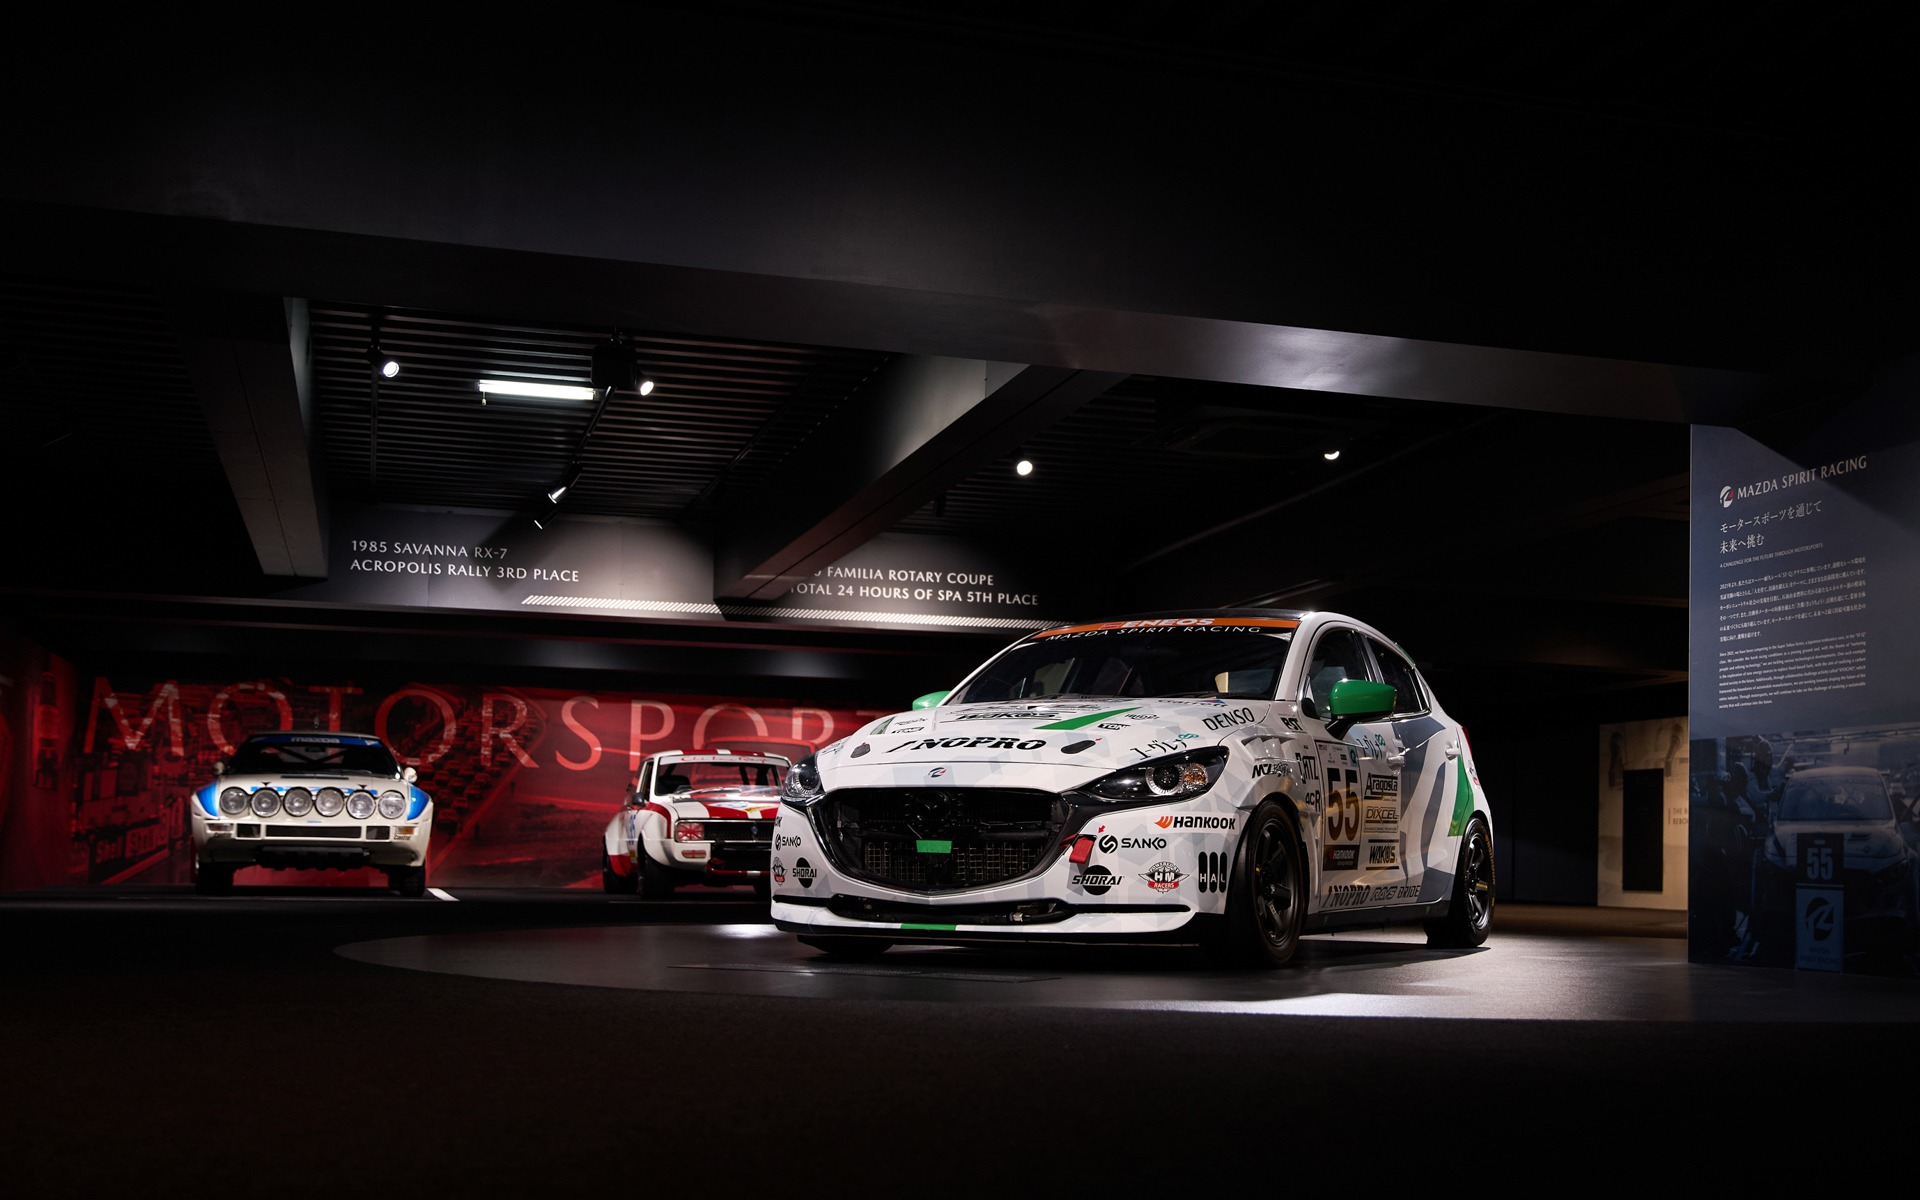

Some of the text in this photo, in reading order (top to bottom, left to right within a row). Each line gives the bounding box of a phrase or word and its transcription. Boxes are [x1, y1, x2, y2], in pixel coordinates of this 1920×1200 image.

[1737, 456, 1868, 500] MAZDA SPIRIT RACING
[1720, 500, 1822, 534] モータースポーツを通じて
[351, 540, 508, 560] 1985 SAVANNA RX-7
[1720, 534, 1764, 554] 未来へ挑む
[350, 559, 580, 582] ACROPOLIS RALLY 3RD PLACE
[828, 566, 884, 580] FAMILIA
[888, 570, 942, 584] ROTARY
[947, 572, 994, 586] COUPE
[838, 586, 854, 597] 24
[860, 586, 910, 600] HOURS
[914, 589, 932, 600] OF
[938, 590, 962, 602] SPA
[967, 592, 992, 604] 5TH
[998, 593, 1038, 606] PLACE
[1122, 618, 1216, 628] ENEOS
[1046, 626, 1261, 642] MAZDA SPIRIT RACING
[84, 676, 882, 771] MOTORSPOR
[1202, 708, 1255, 732] DENSO
[911, 737, 1046, 751] NOPRO
[1364, 772, 1398, 797] Aragosta
[1327, 768, 1360, 842] 55
[1366, 806, 1399, 824] DIXCEL
[782, 835, 802, 848] SANKO
[1121, 838, 1167, 850] SANKO
[792, 868, 817, 878] SHORAI
[1806, 847, 1833, 882] 55
[1072, 875, 1122, 886] SHORAI
[1154, 881, 1176, 889] RACERS
[1200, 872, 1226, 884] HAL
[1397, 885, 1421, 899] BRIDE
